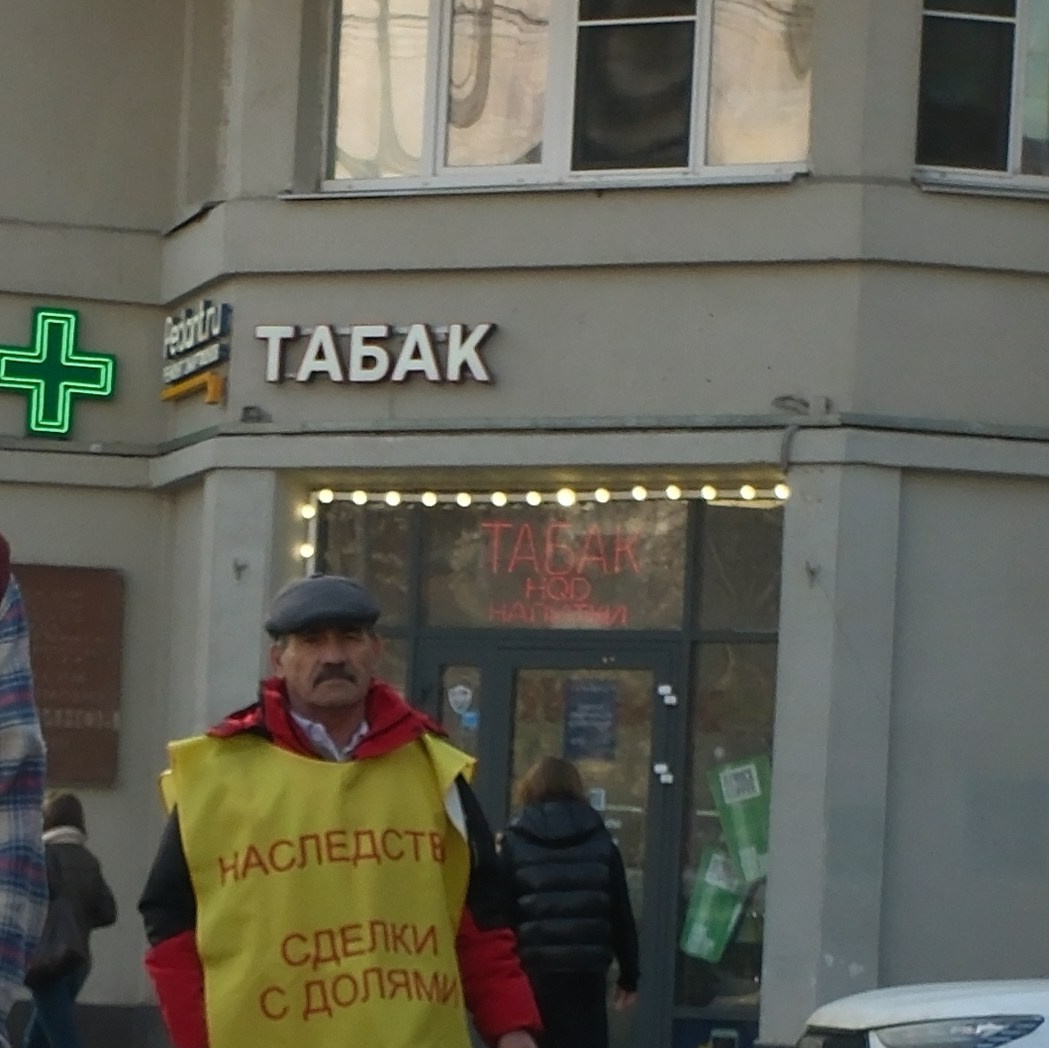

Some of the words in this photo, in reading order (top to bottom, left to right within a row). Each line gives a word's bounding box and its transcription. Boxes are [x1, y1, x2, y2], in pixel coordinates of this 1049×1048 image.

[255, 323, 494, 382] ТАБАК
[481, 522, 641, 574] ТАБАК
[526, 577, 591, 600] HQD
[280, 920, 439, 971] СДЕЛКИ
[259, 986, 289, 1020] С
[302, 967, 460, 1021] ДОЛЯМИ
